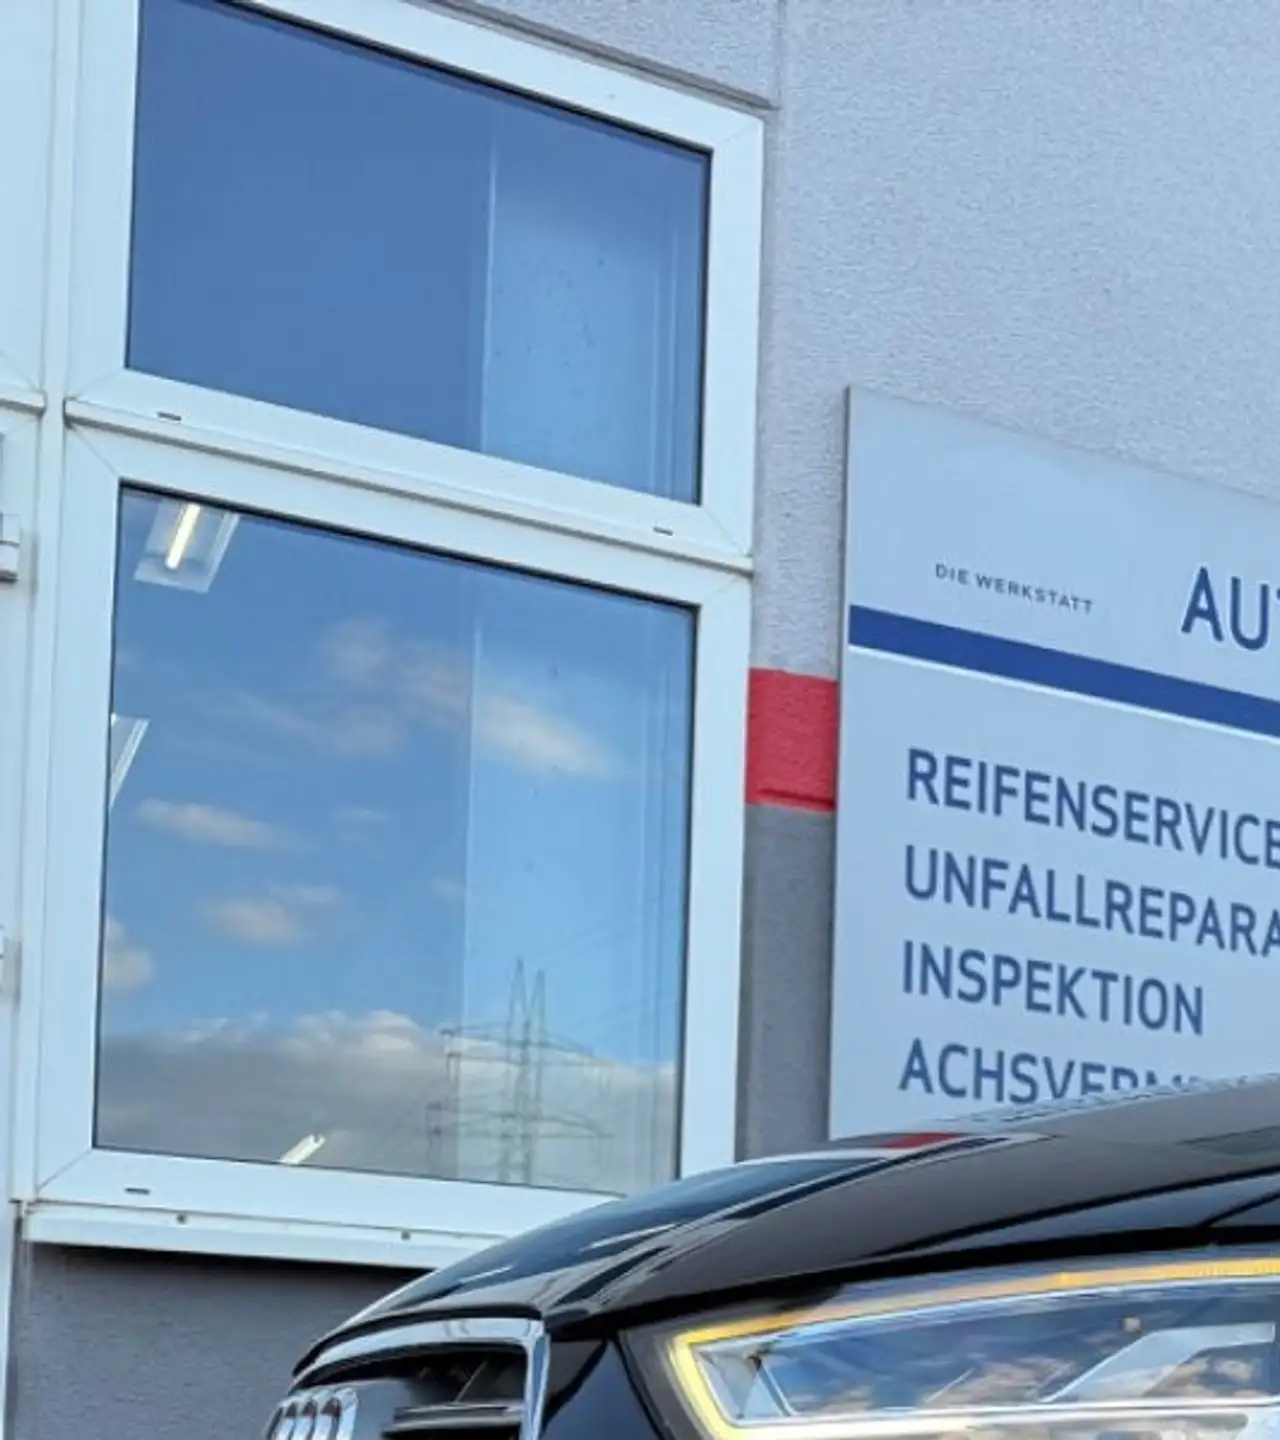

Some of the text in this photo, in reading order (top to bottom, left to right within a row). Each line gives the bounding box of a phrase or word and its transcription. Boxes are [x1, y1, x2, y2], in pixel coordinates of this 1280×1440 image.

[935, 563, 1094, 614] DIE WERKSTATT
[903, 940, 1204, 1036] INSPEKTION
